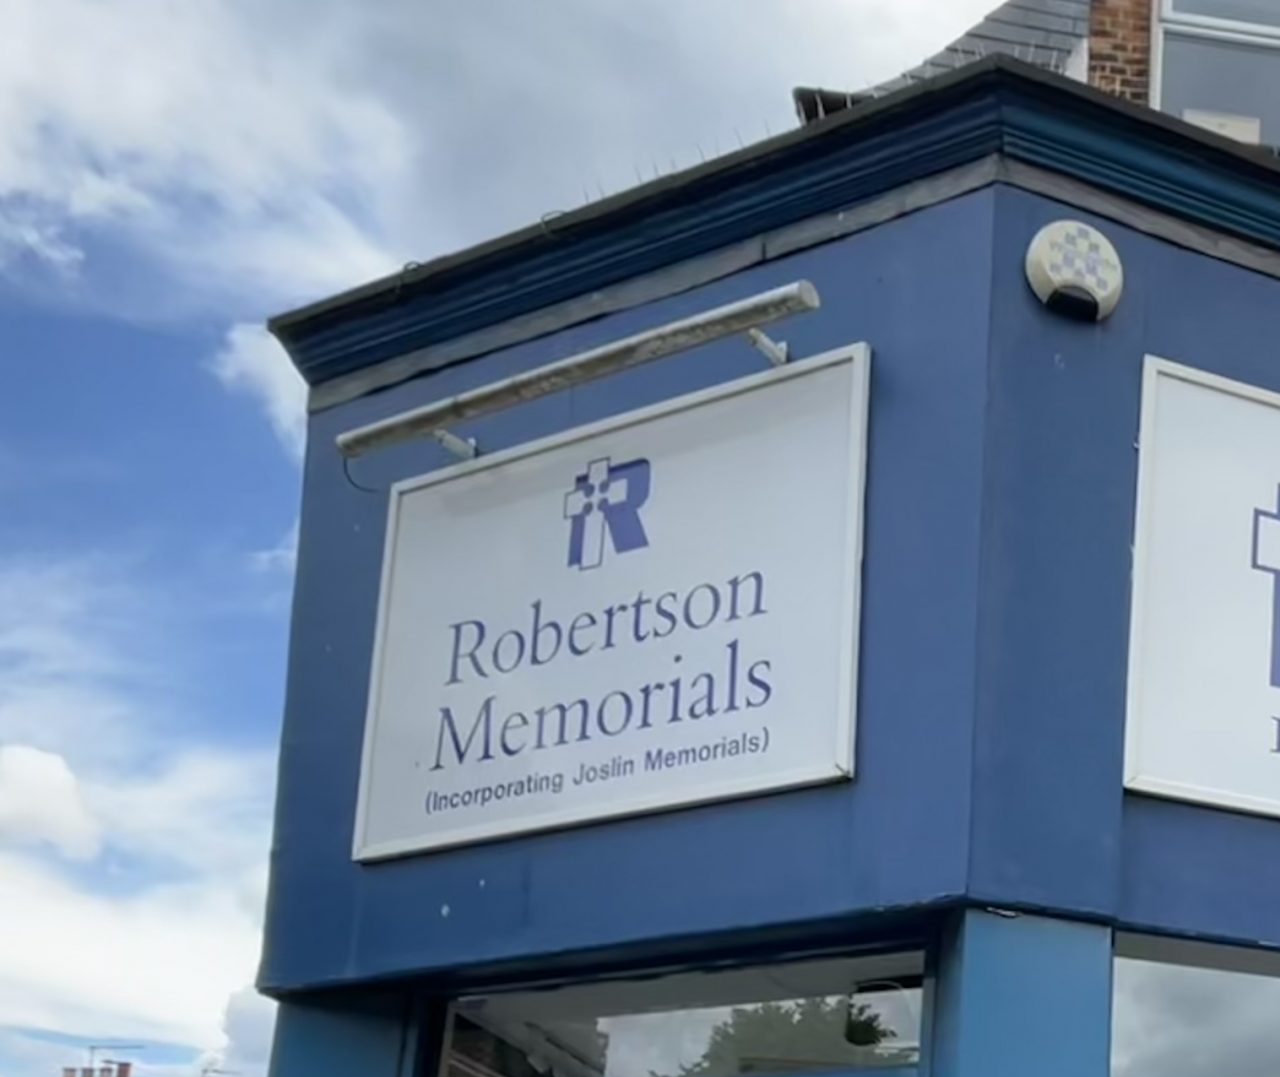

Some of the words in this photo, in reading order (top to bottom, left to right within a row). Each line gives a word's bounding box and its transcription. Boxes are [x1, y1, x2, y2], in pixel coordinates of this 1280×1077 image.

[444, 568, 768, 686] Robertson
[430, 638, 773, 771] Memorials
[425, 769, 564, 815] (Incorporating
[572, 756, 635, 787] Joslin
[645, 727, 770, 772] Memorials)
